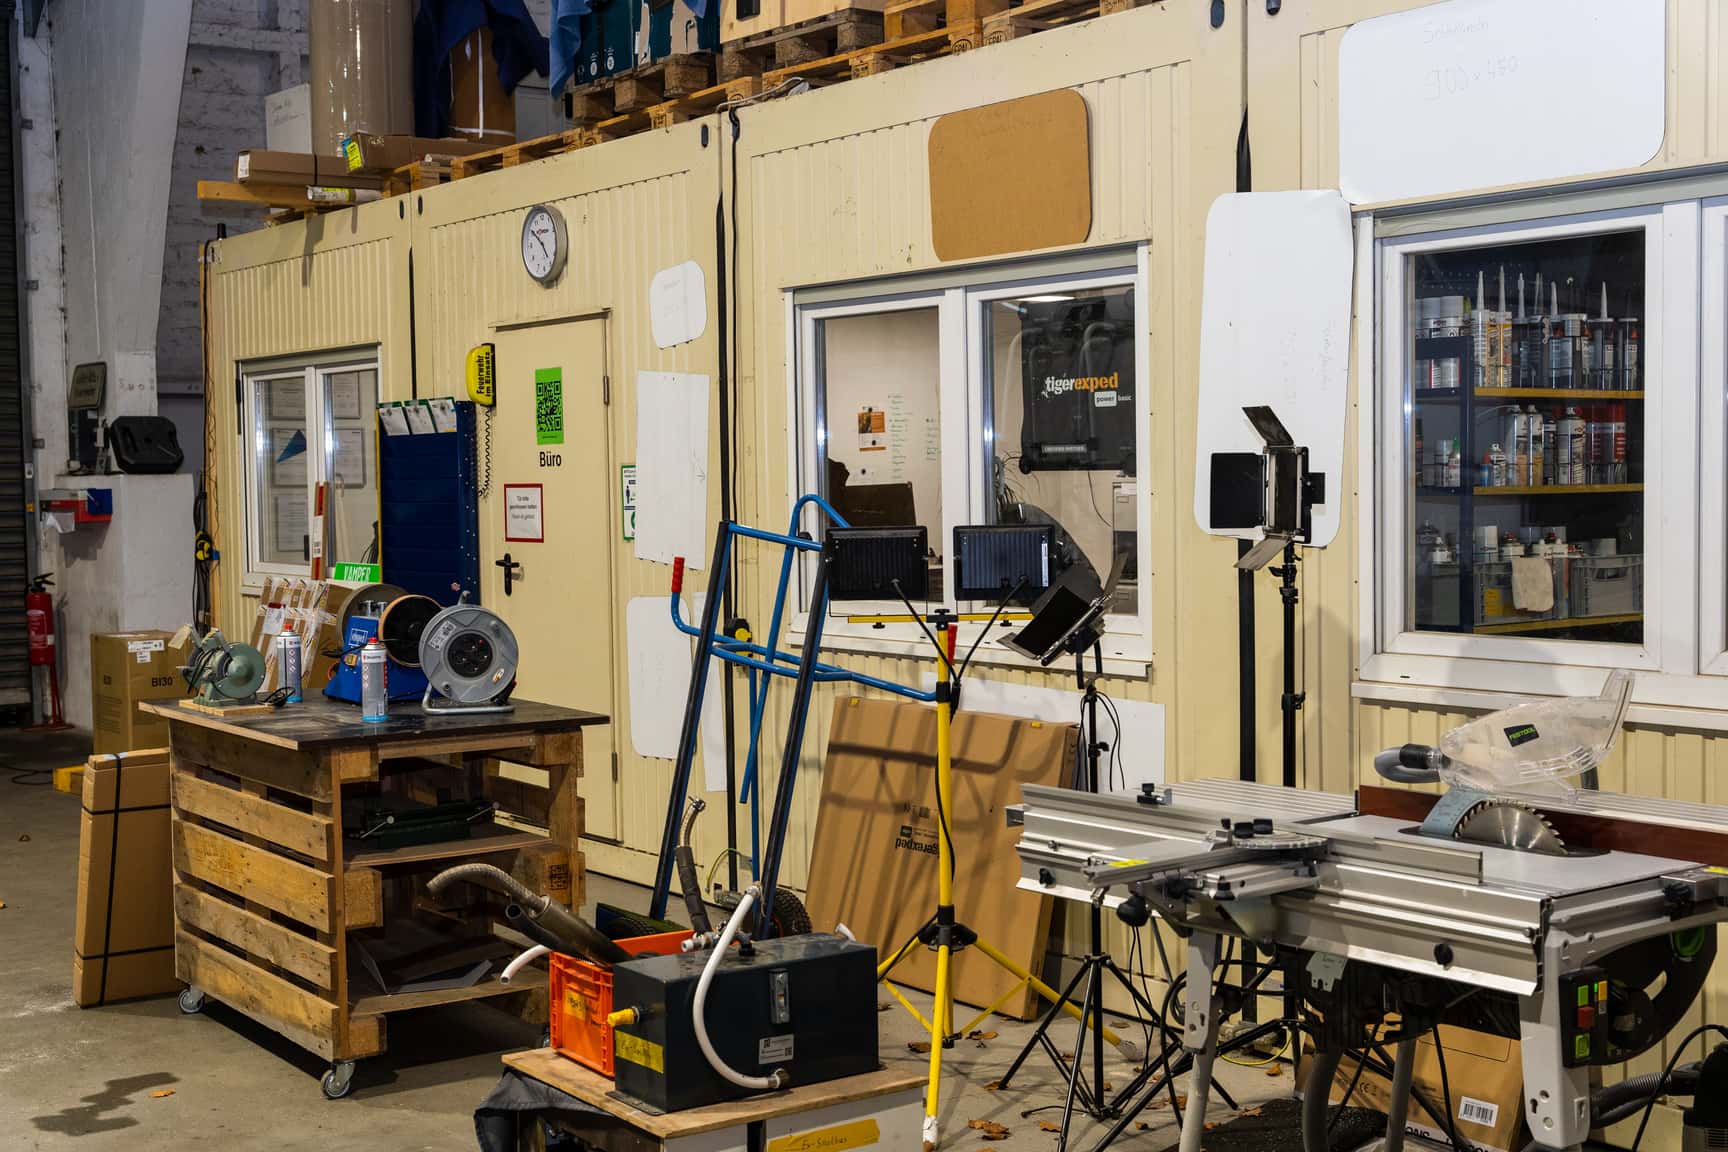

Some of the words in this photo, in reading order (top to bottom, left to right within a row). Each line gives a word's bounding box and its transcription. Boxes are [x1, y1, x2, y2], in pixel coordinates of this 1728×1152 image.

[475, 355, 484, 394] Feuerwehr
[1044, 371, 1119, 395] tigerexped
[485, 387, 491, 397] im
[539, 451, 562, 467] Büro
[895, 838, 938, 856] gerexped
